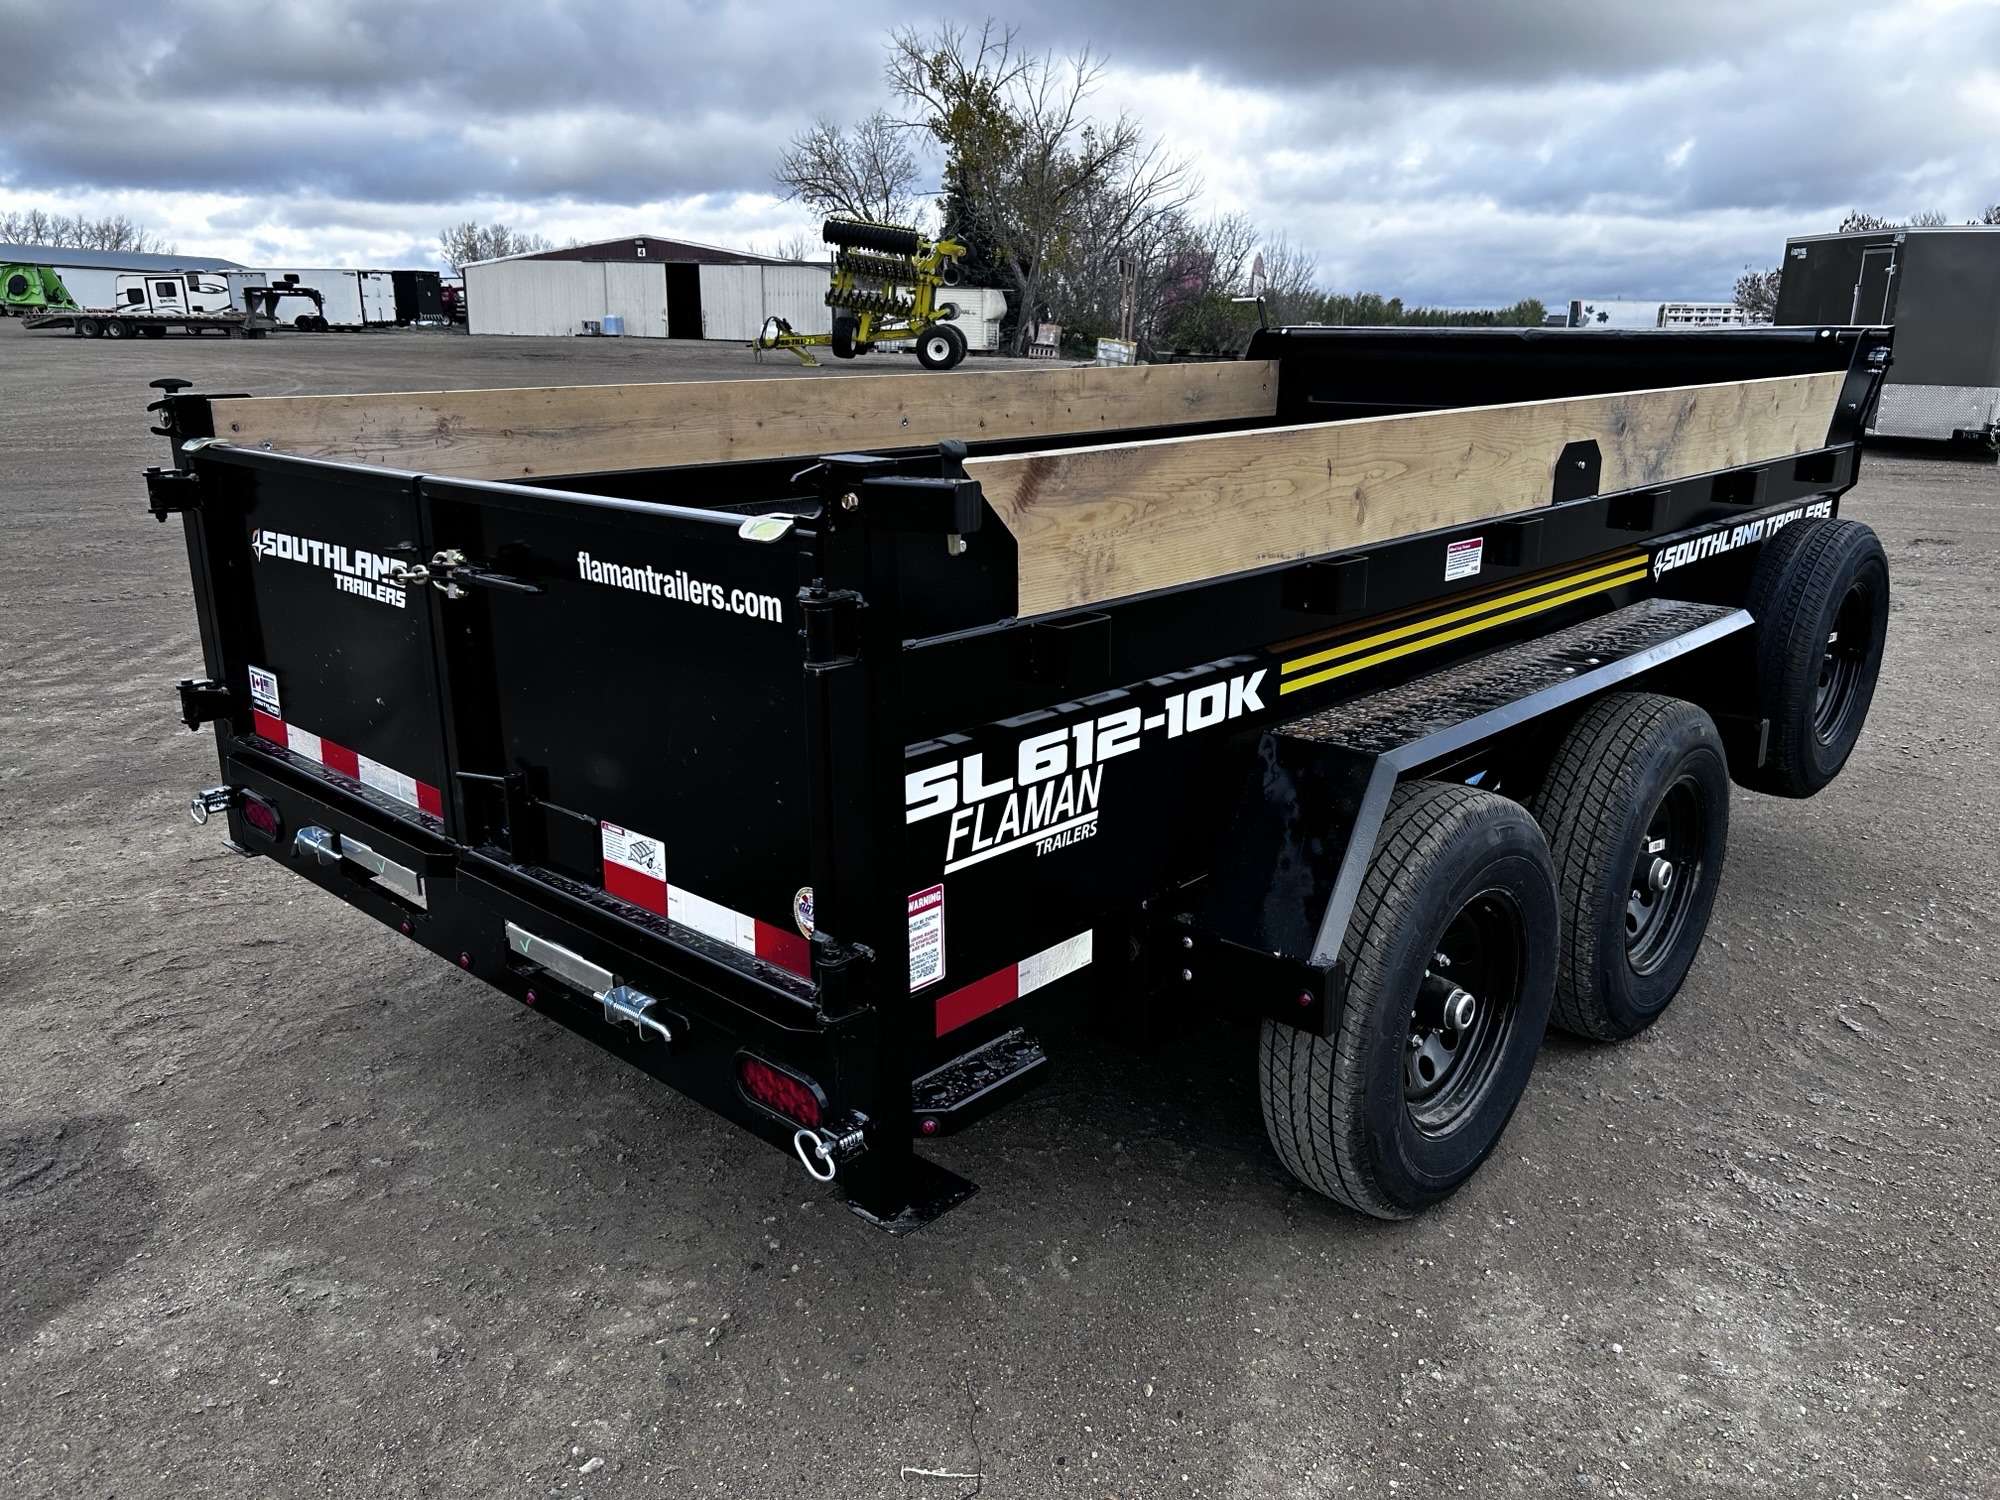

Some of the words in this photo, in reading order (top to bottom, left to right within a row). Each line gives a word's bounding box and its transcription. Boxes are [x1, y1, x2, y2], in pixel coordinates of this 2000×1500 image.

[1662, 519, 1766, 573] SOUTHLAND
[333, 572, 407, 609] TRAILERS
[577, 551, 783, 624] flamantrailers.com
[904, 668, 1268, 825] SL612-10K
[945, 763, 1104, 862] FLAMAN
[1035, 820, 1098, 857] TRAILERS
